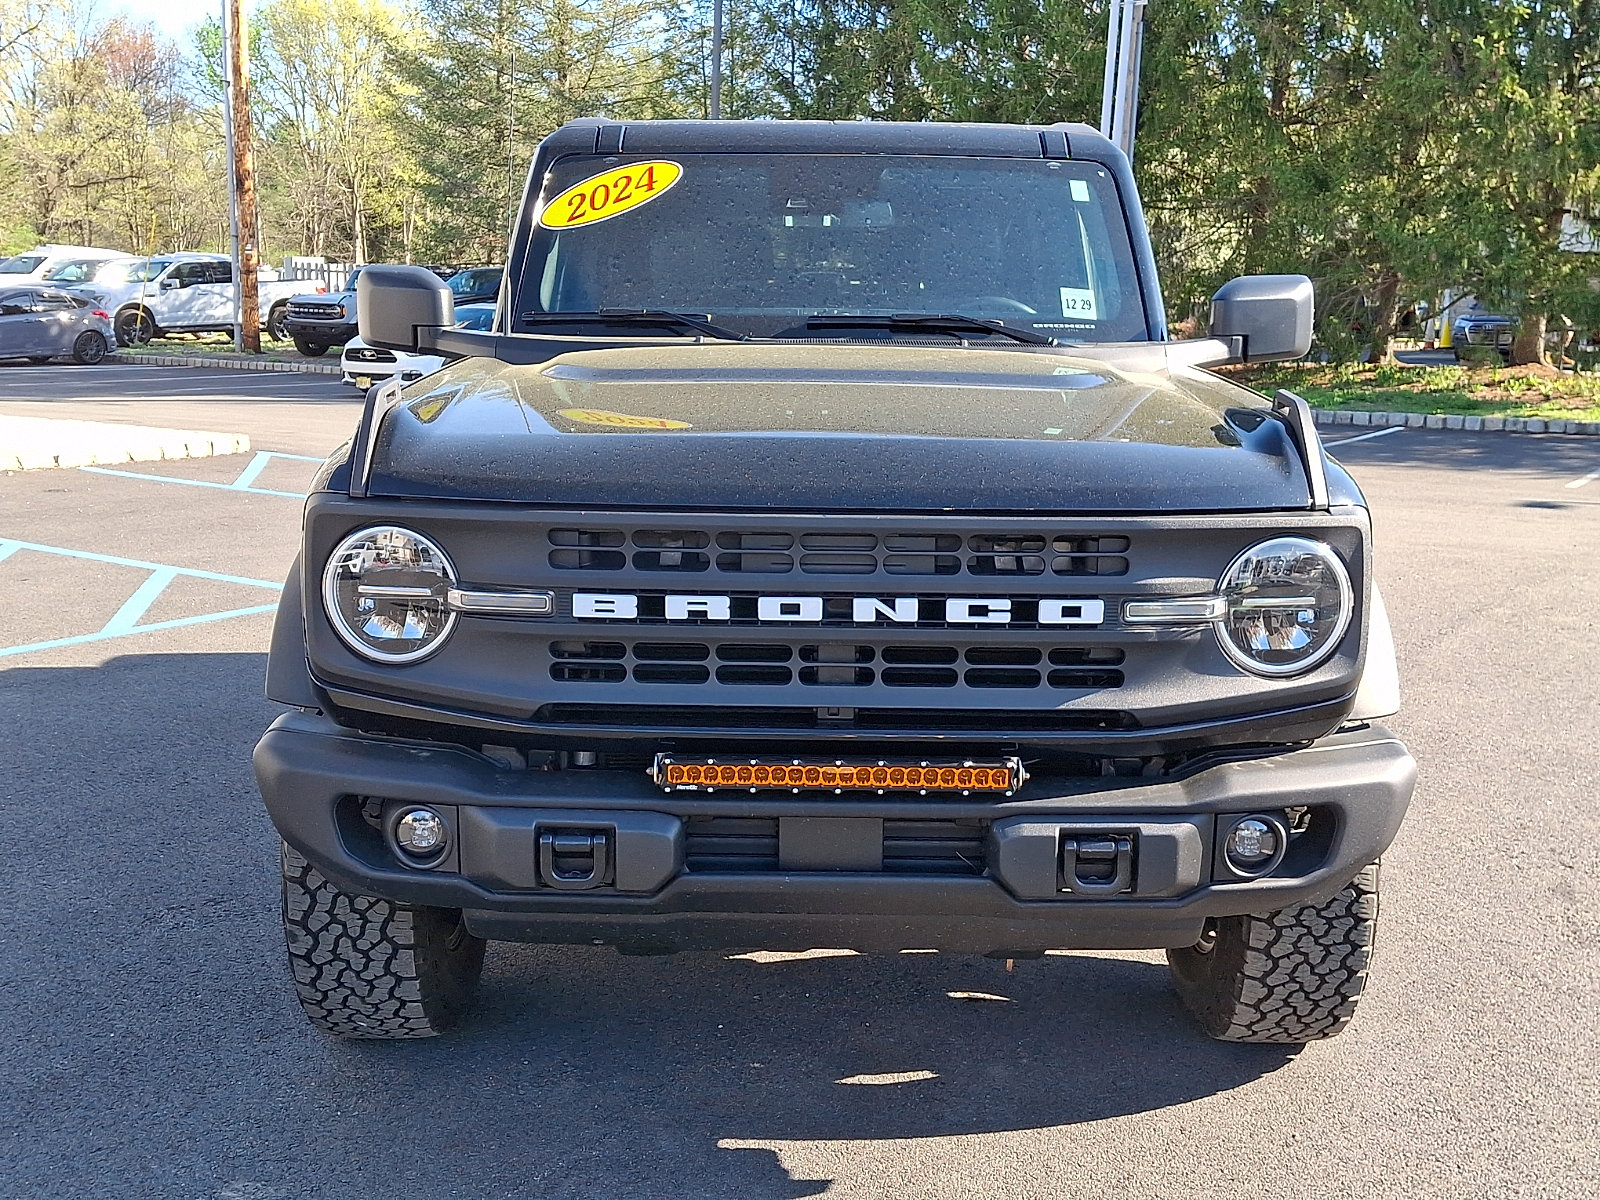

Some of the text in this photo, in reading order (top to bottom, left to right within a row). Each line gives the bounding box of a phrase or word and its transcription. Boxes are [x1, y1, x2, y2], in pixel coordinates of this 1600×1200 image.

[567, 165, 658, 223] 2024
[1065, 298, 1092, 311] 12 29
[572, 592, 1105, 624] BRONCO
